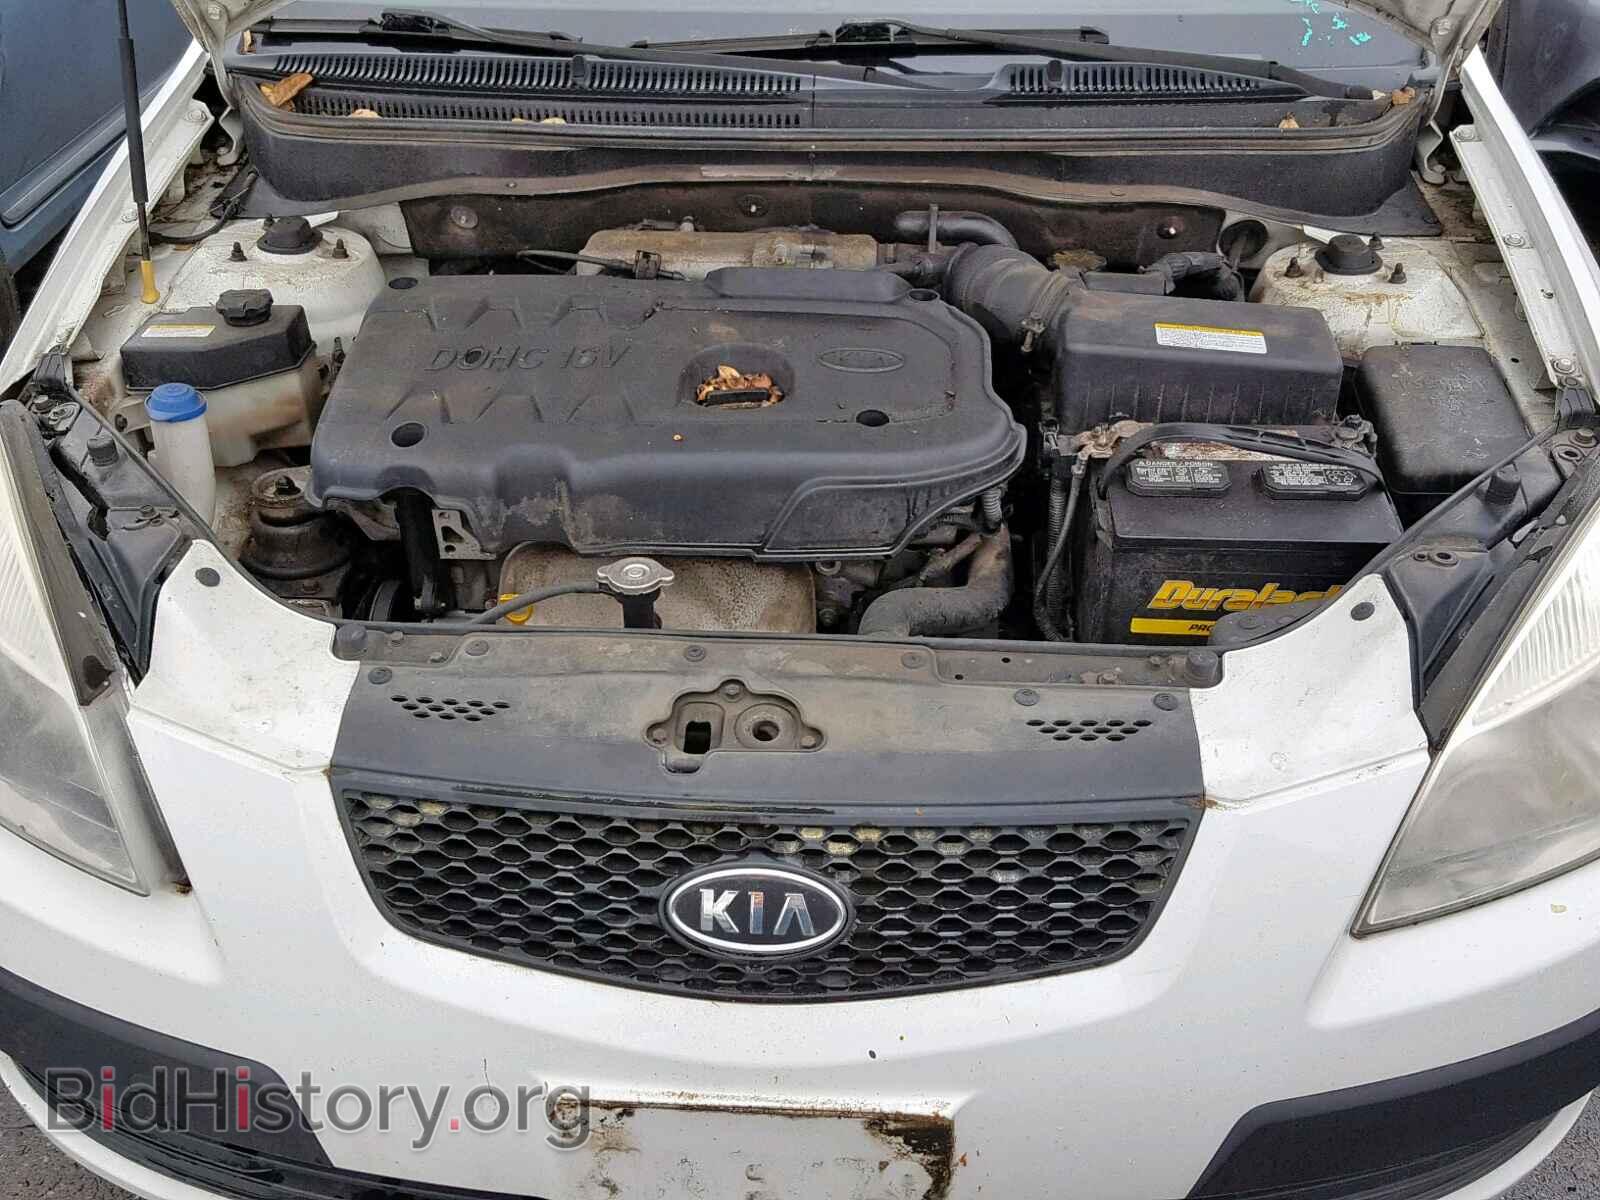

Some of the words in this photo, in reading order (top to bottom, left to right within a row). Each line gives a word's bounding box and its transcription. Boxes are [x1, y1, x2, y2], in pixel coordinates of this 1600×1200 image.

[424, 346, 550, 371] DOHC
[559, 346, 632, 369] 16V
[1147, 579, 1345, 611] Durala
[700, 888, 817, 936] KIA
